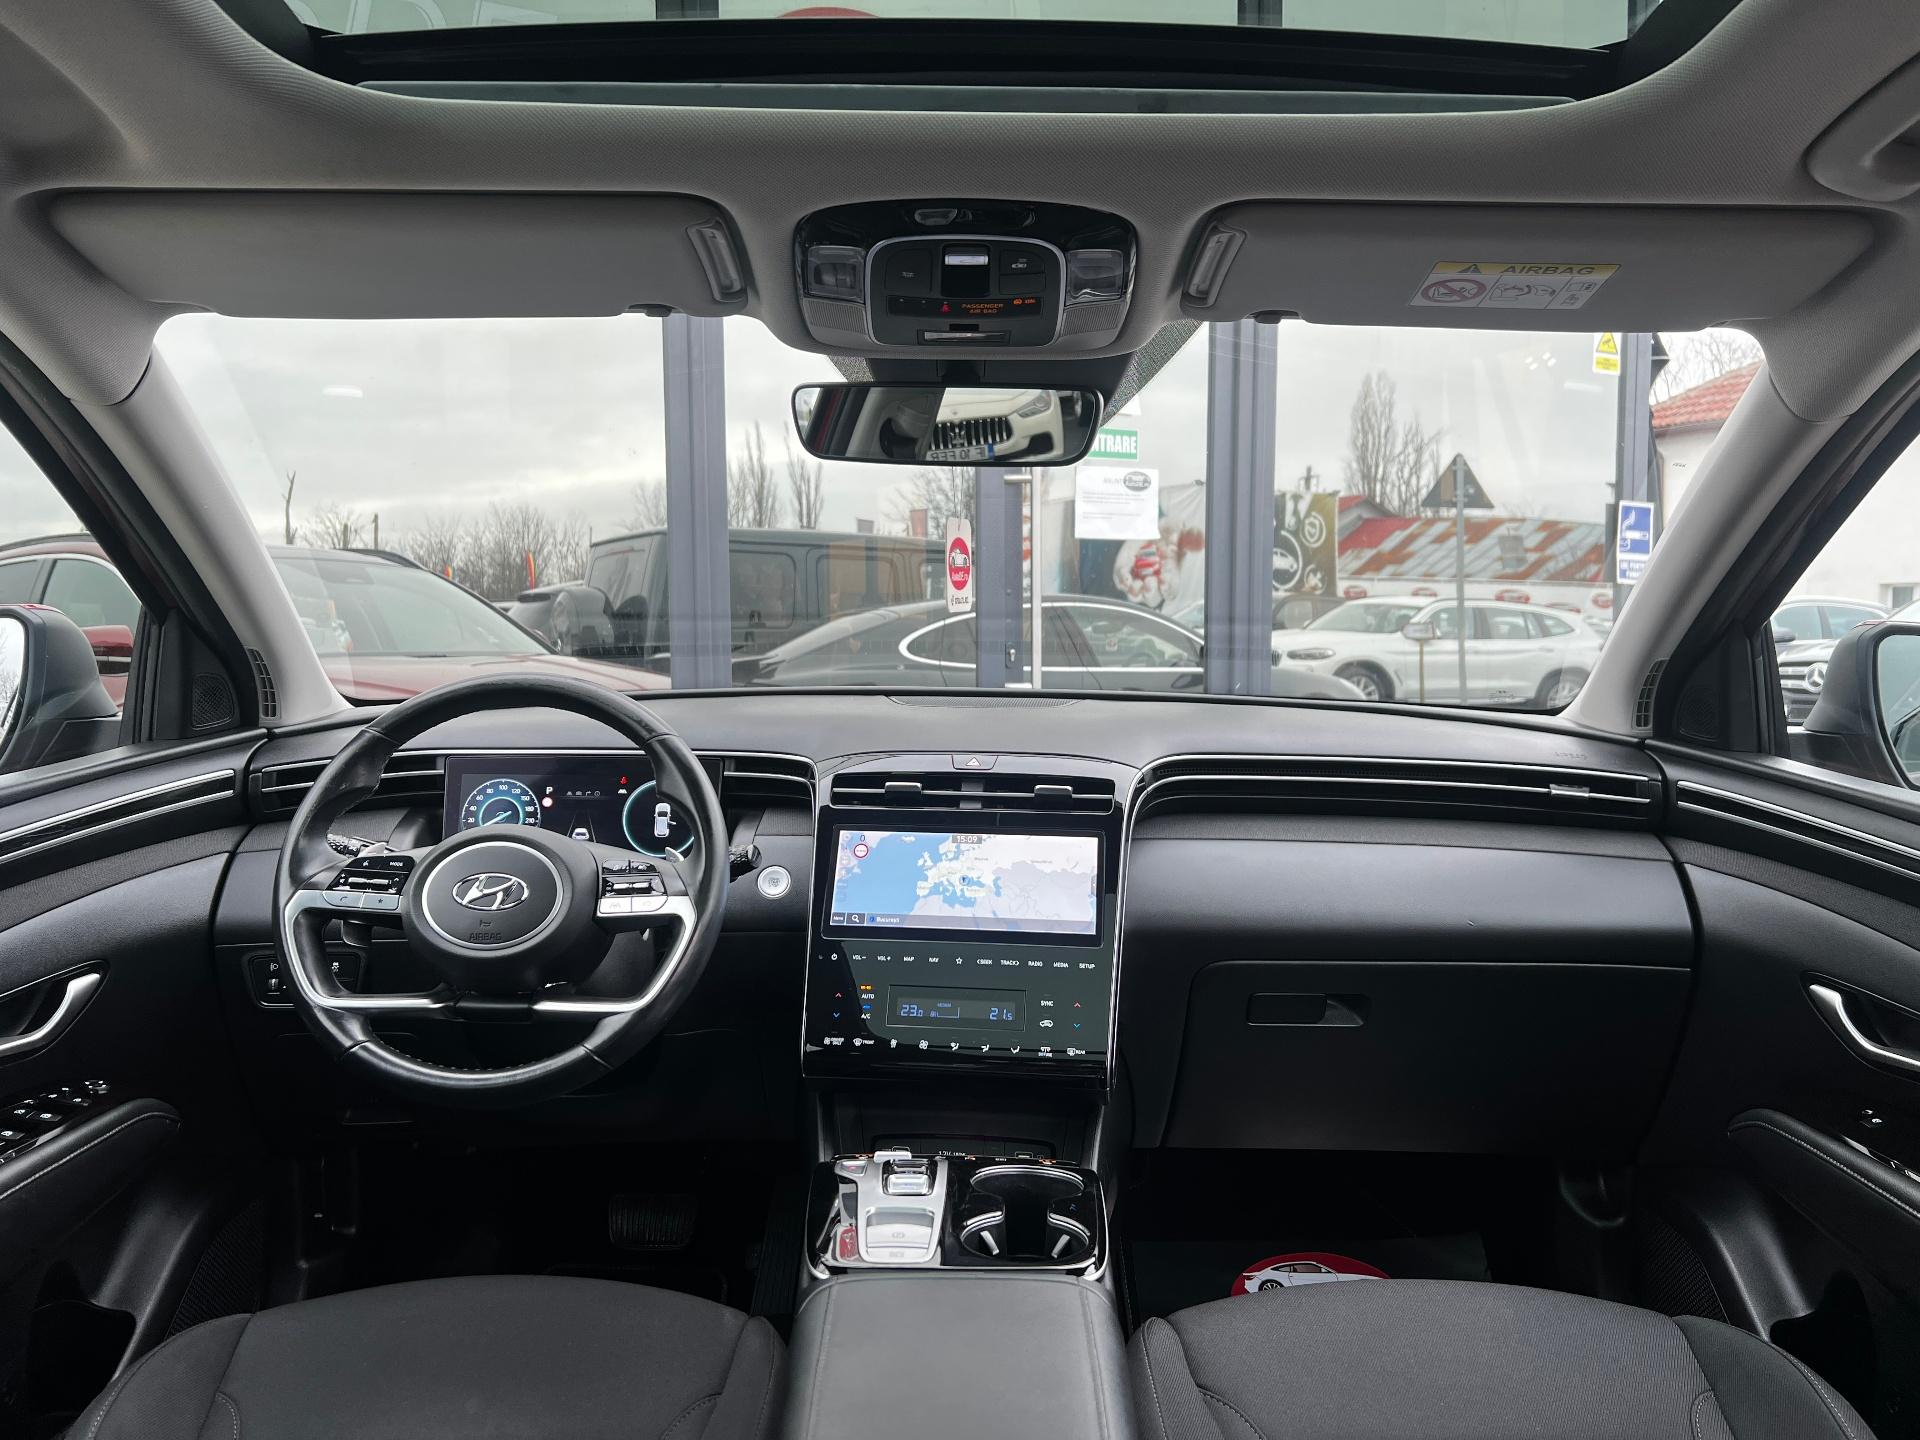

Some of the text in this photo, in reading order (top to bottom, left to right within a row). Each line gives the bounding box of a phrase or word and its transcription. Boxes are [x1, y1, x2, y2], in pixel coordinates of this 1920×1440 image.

[1500, 265, 1596, 275] AIRBAG
[1091, 433, 1136, 453] NTRARE
[545, 786, 553, 795] P
[957, 835, 977, 843] 15:09
[469, 932, 502, 940] AIRBAG
